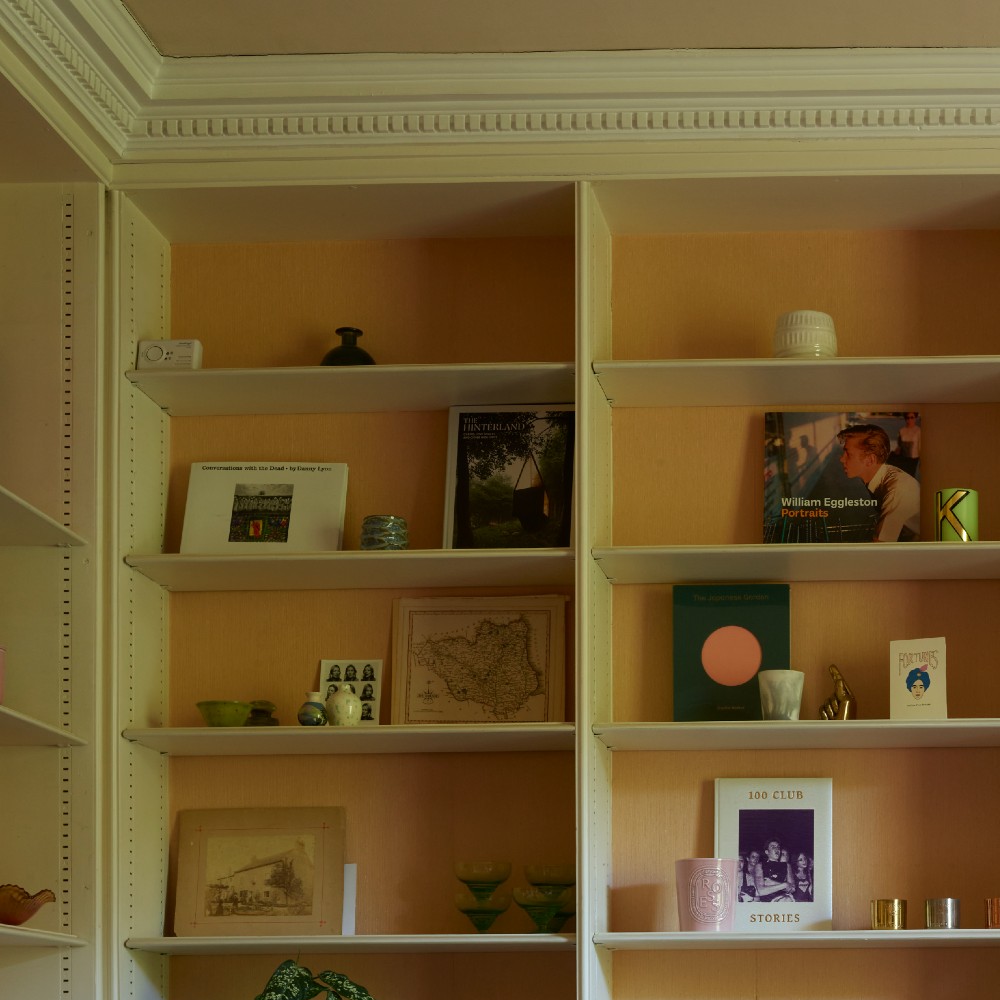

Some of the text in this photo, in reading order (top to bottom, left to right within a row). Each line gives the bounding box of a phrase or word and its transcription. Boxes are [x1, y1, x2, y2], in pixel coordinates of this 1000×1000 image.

[464, 423, 525, 431] HINTERLAND
[781, 497, 878, 509] William Eggleston
[781, 508, 829, 518] Portraits
[936, 489, 972, 542] K
[748, 790, 804, 800] 100 CLUB
[750, 914, 800, 922] STORIES
